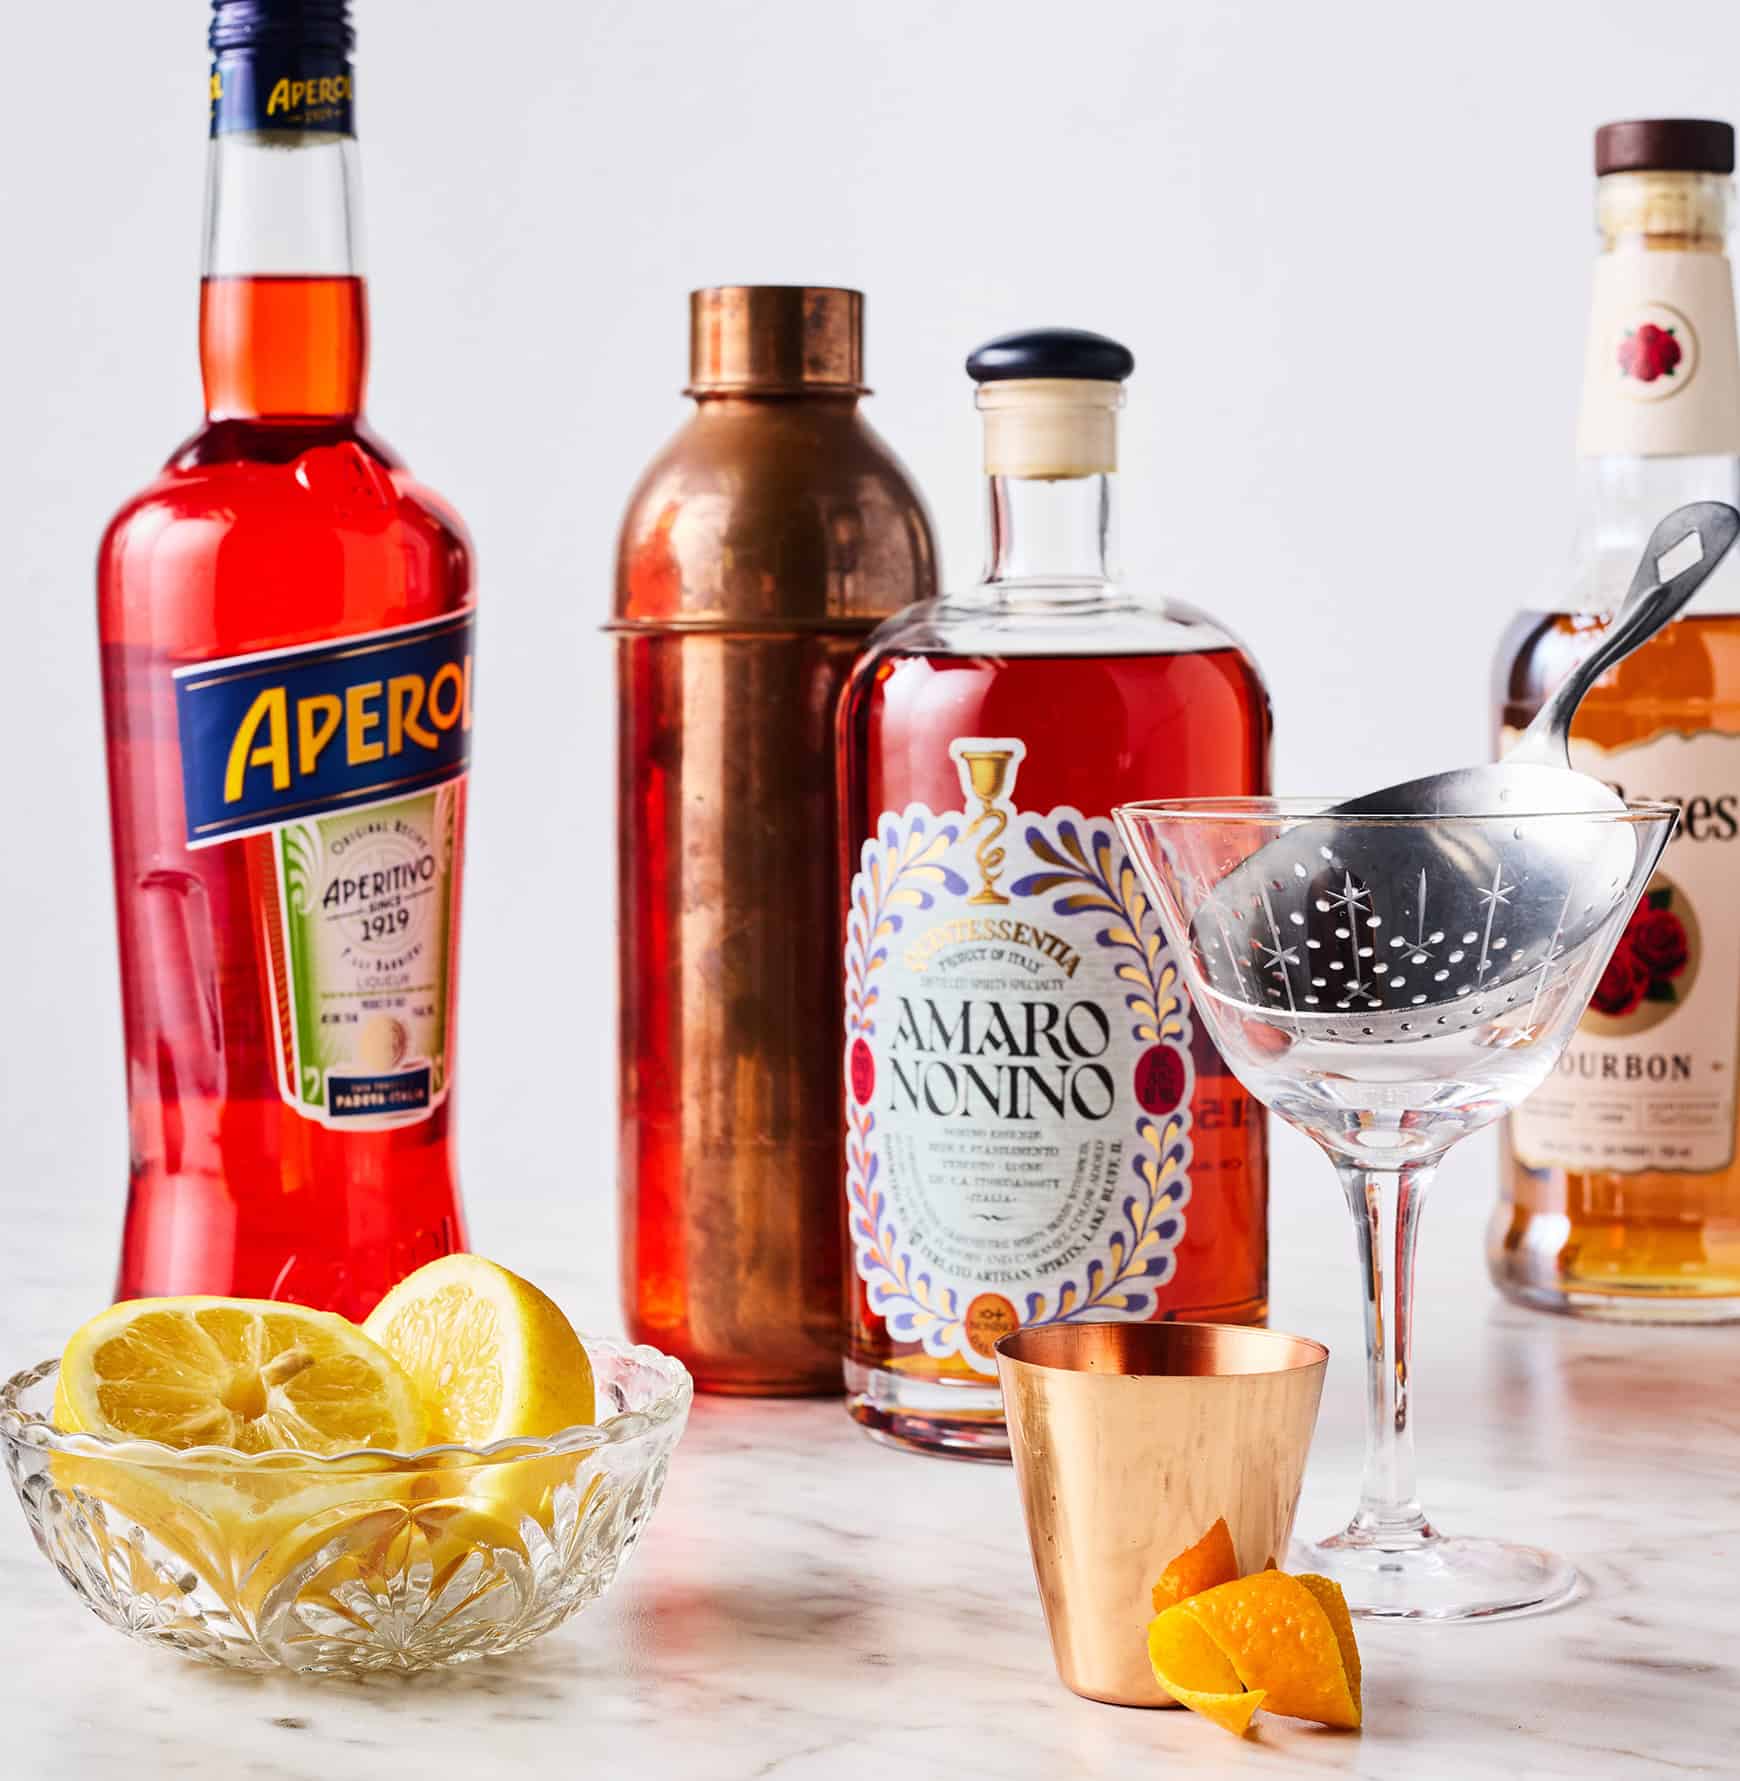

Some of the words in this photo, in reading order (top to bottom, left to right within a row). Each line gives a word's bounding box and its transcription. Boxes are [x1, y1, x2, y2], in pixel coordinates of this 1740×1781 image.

[323, 854, 436, 909] APERITIVO
[360, 908, 410, 942] 1919
[892, 996, 1111, 1061] AMARO
[889, 1056, 1115, 1121] NONINO
[1559, 1051, 1692, 1082] OURBON
